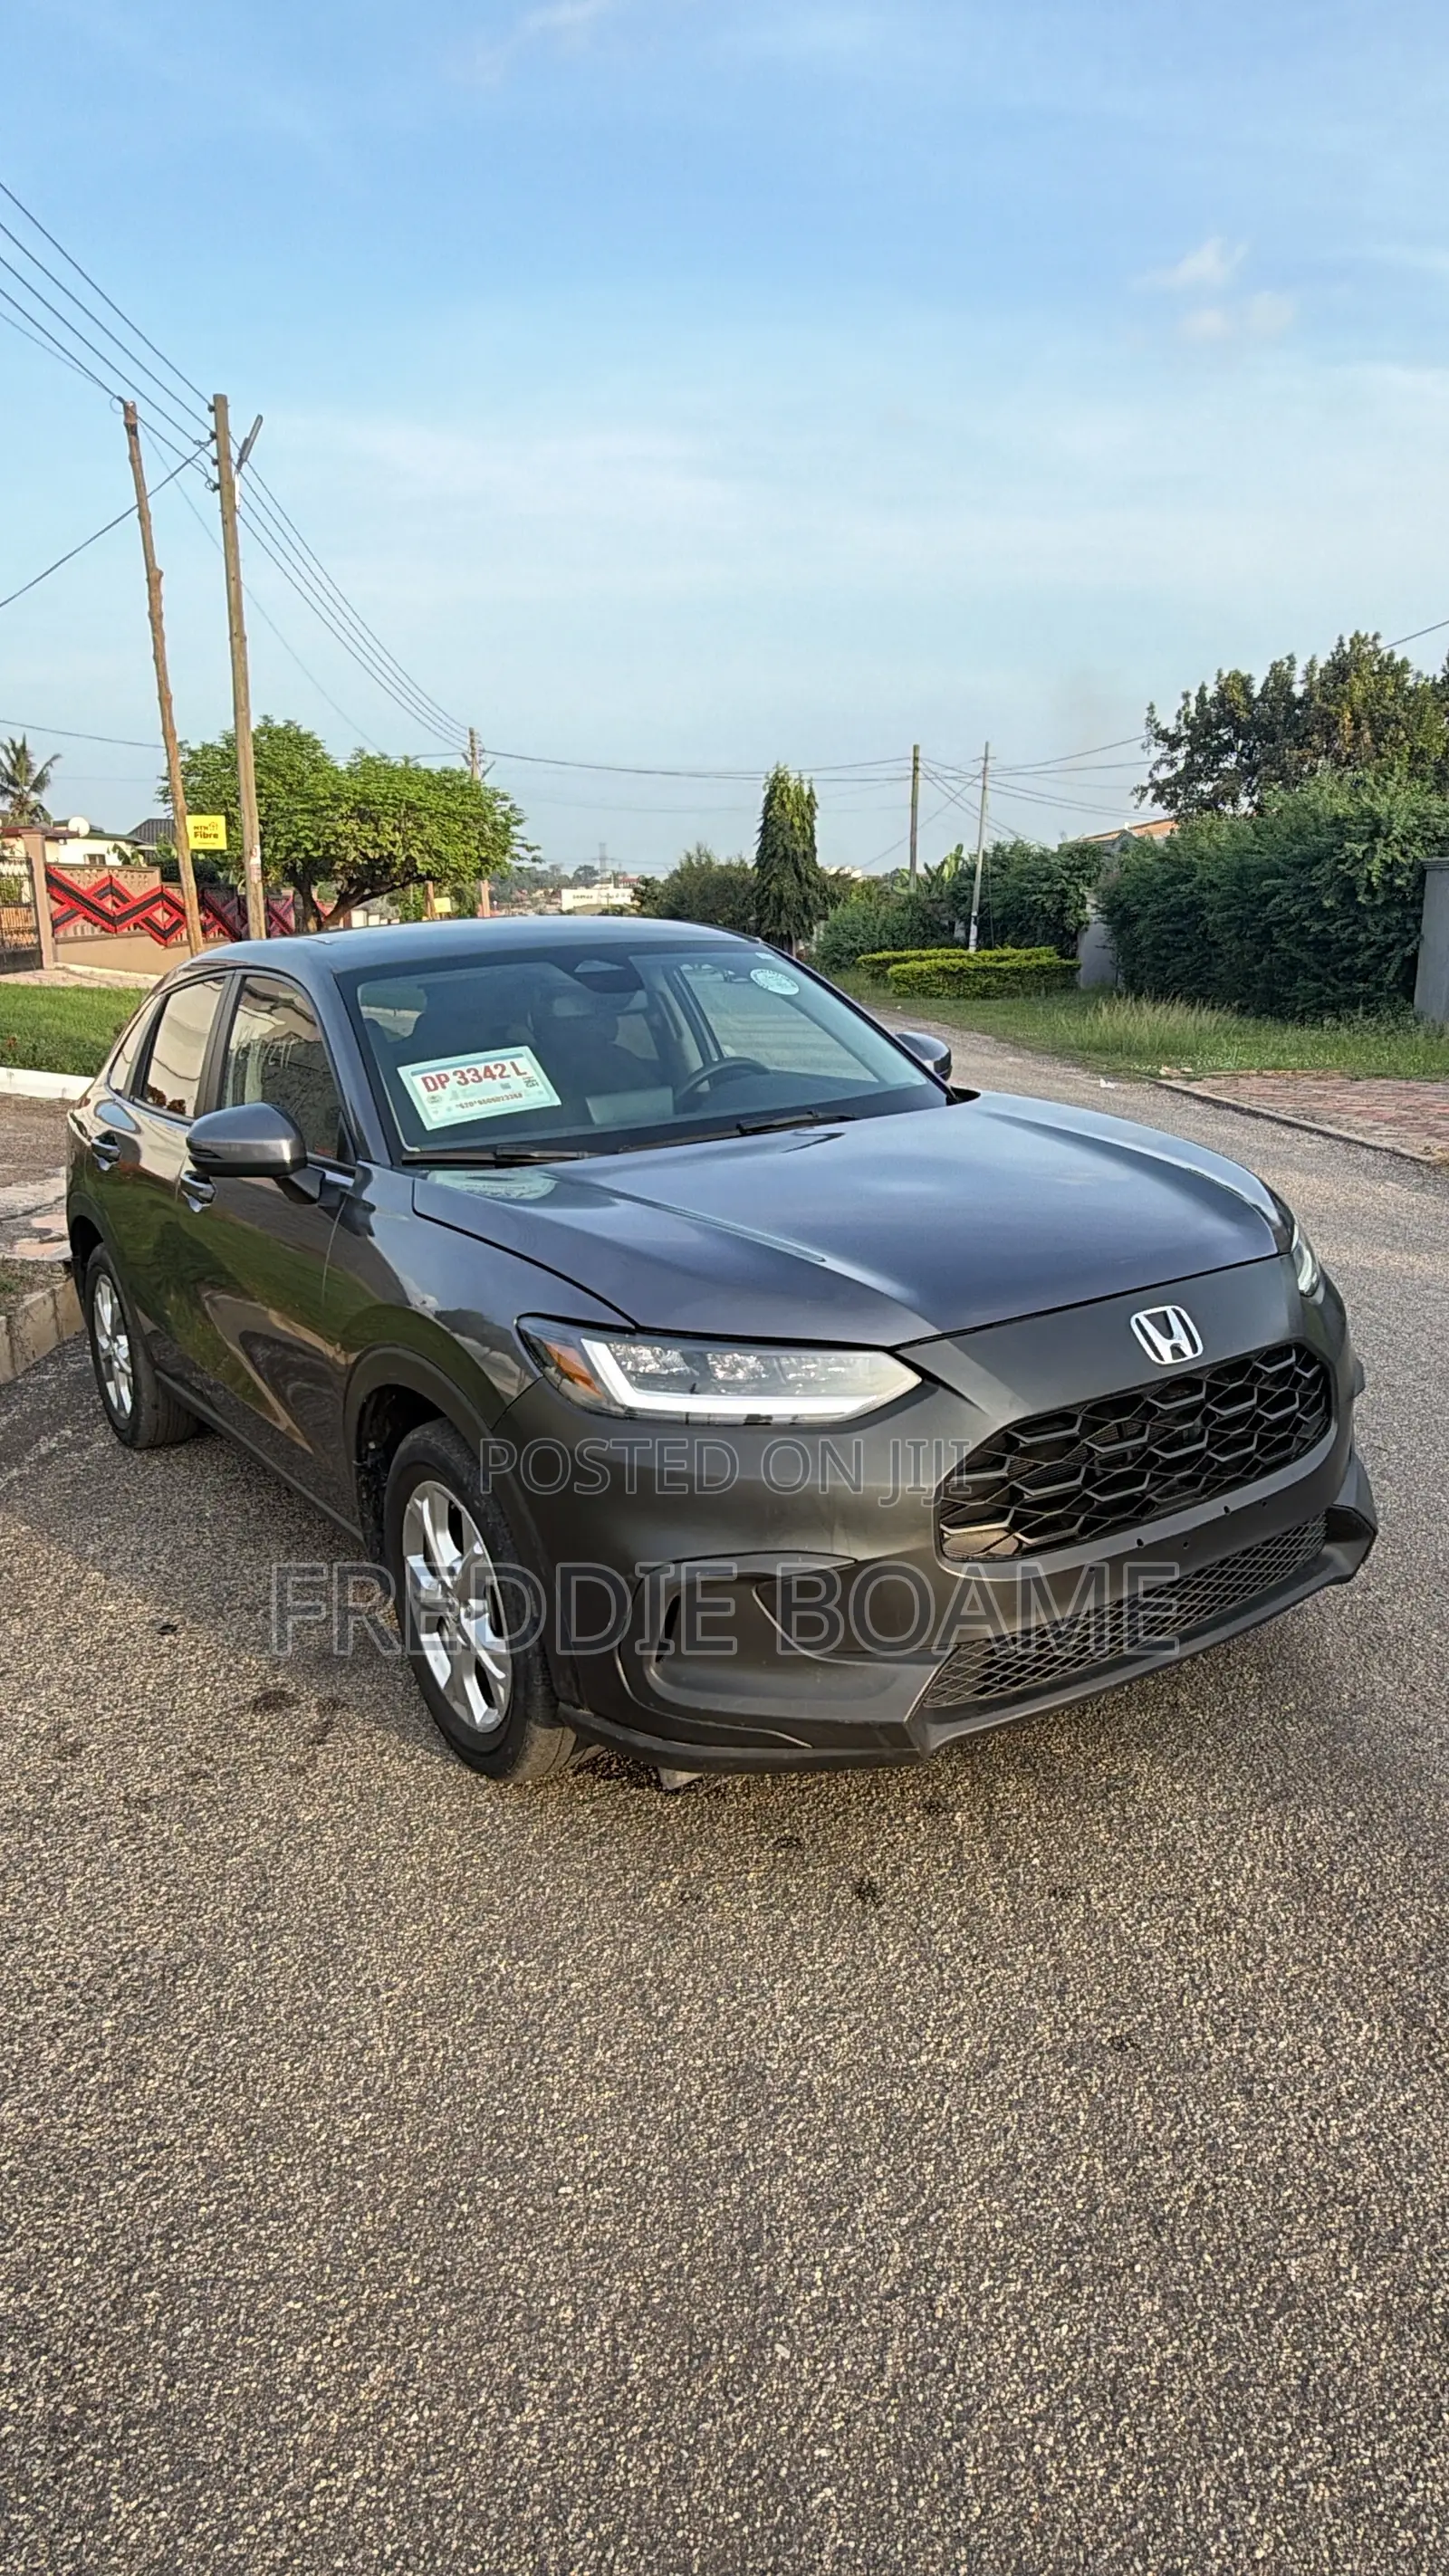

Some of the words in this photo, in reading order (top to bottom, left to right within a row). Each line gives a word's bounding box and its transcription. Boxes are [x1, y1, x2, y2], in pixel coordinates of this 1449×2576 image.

[420, 1073, 451, 1093] DP
[452, 1063, 511, 1087] 3342
[509, 1060, 527, 1077] L
